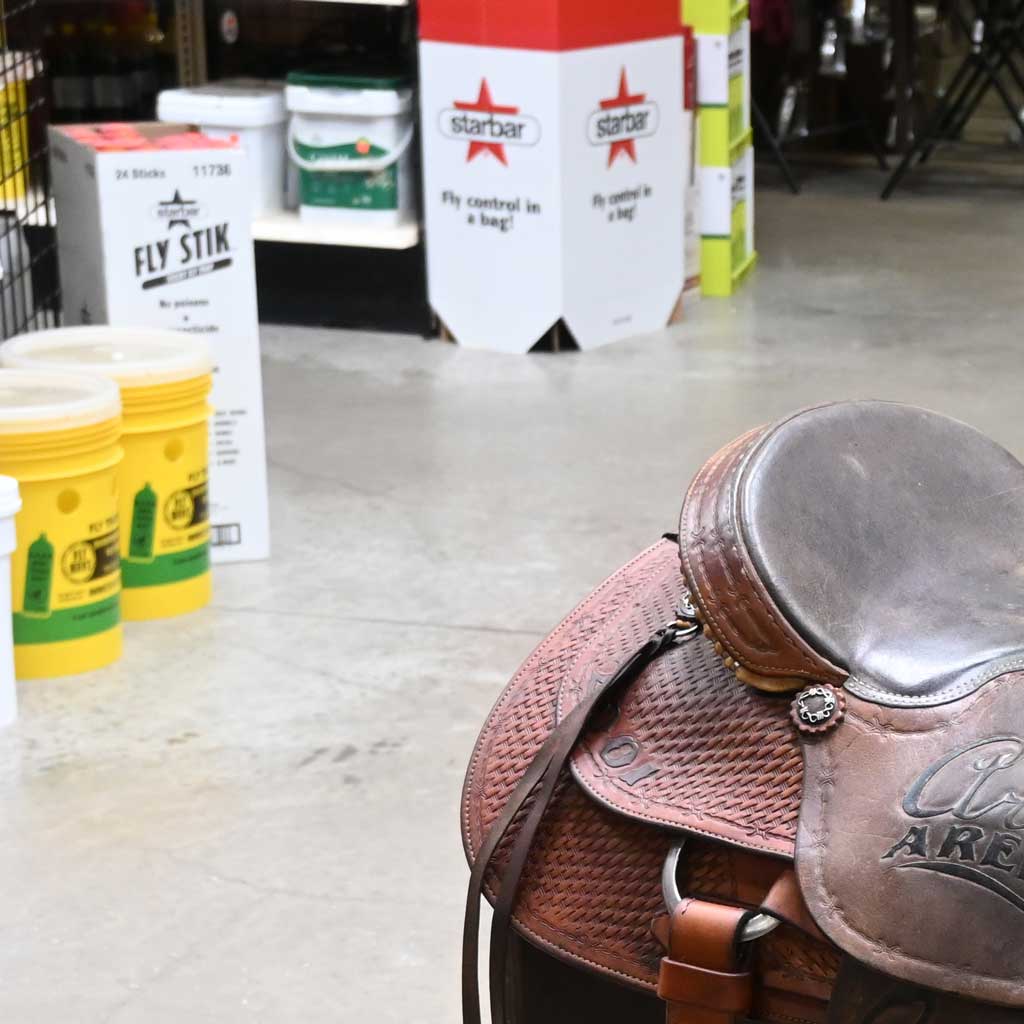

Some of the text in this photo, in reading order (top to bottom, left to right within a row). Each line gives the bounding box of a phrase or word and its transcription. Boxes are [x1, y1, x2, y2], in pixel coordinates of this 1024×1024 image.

[451, 112, 527, 139] starbar
[595, 107, 649, 138] starbar
[115, 169, 166, 180] 24 Sticks
[193, 164, 232, 176] 11736
[442, 190, 541, 214] Fly control in
[592, 192, 606, 210] Fly
[608, 188, 642, 205] control
[467, 212, 514, 232] a bag!
[133, 238, 170, 277] FLY
[179, 222, 230, 264] STIK
